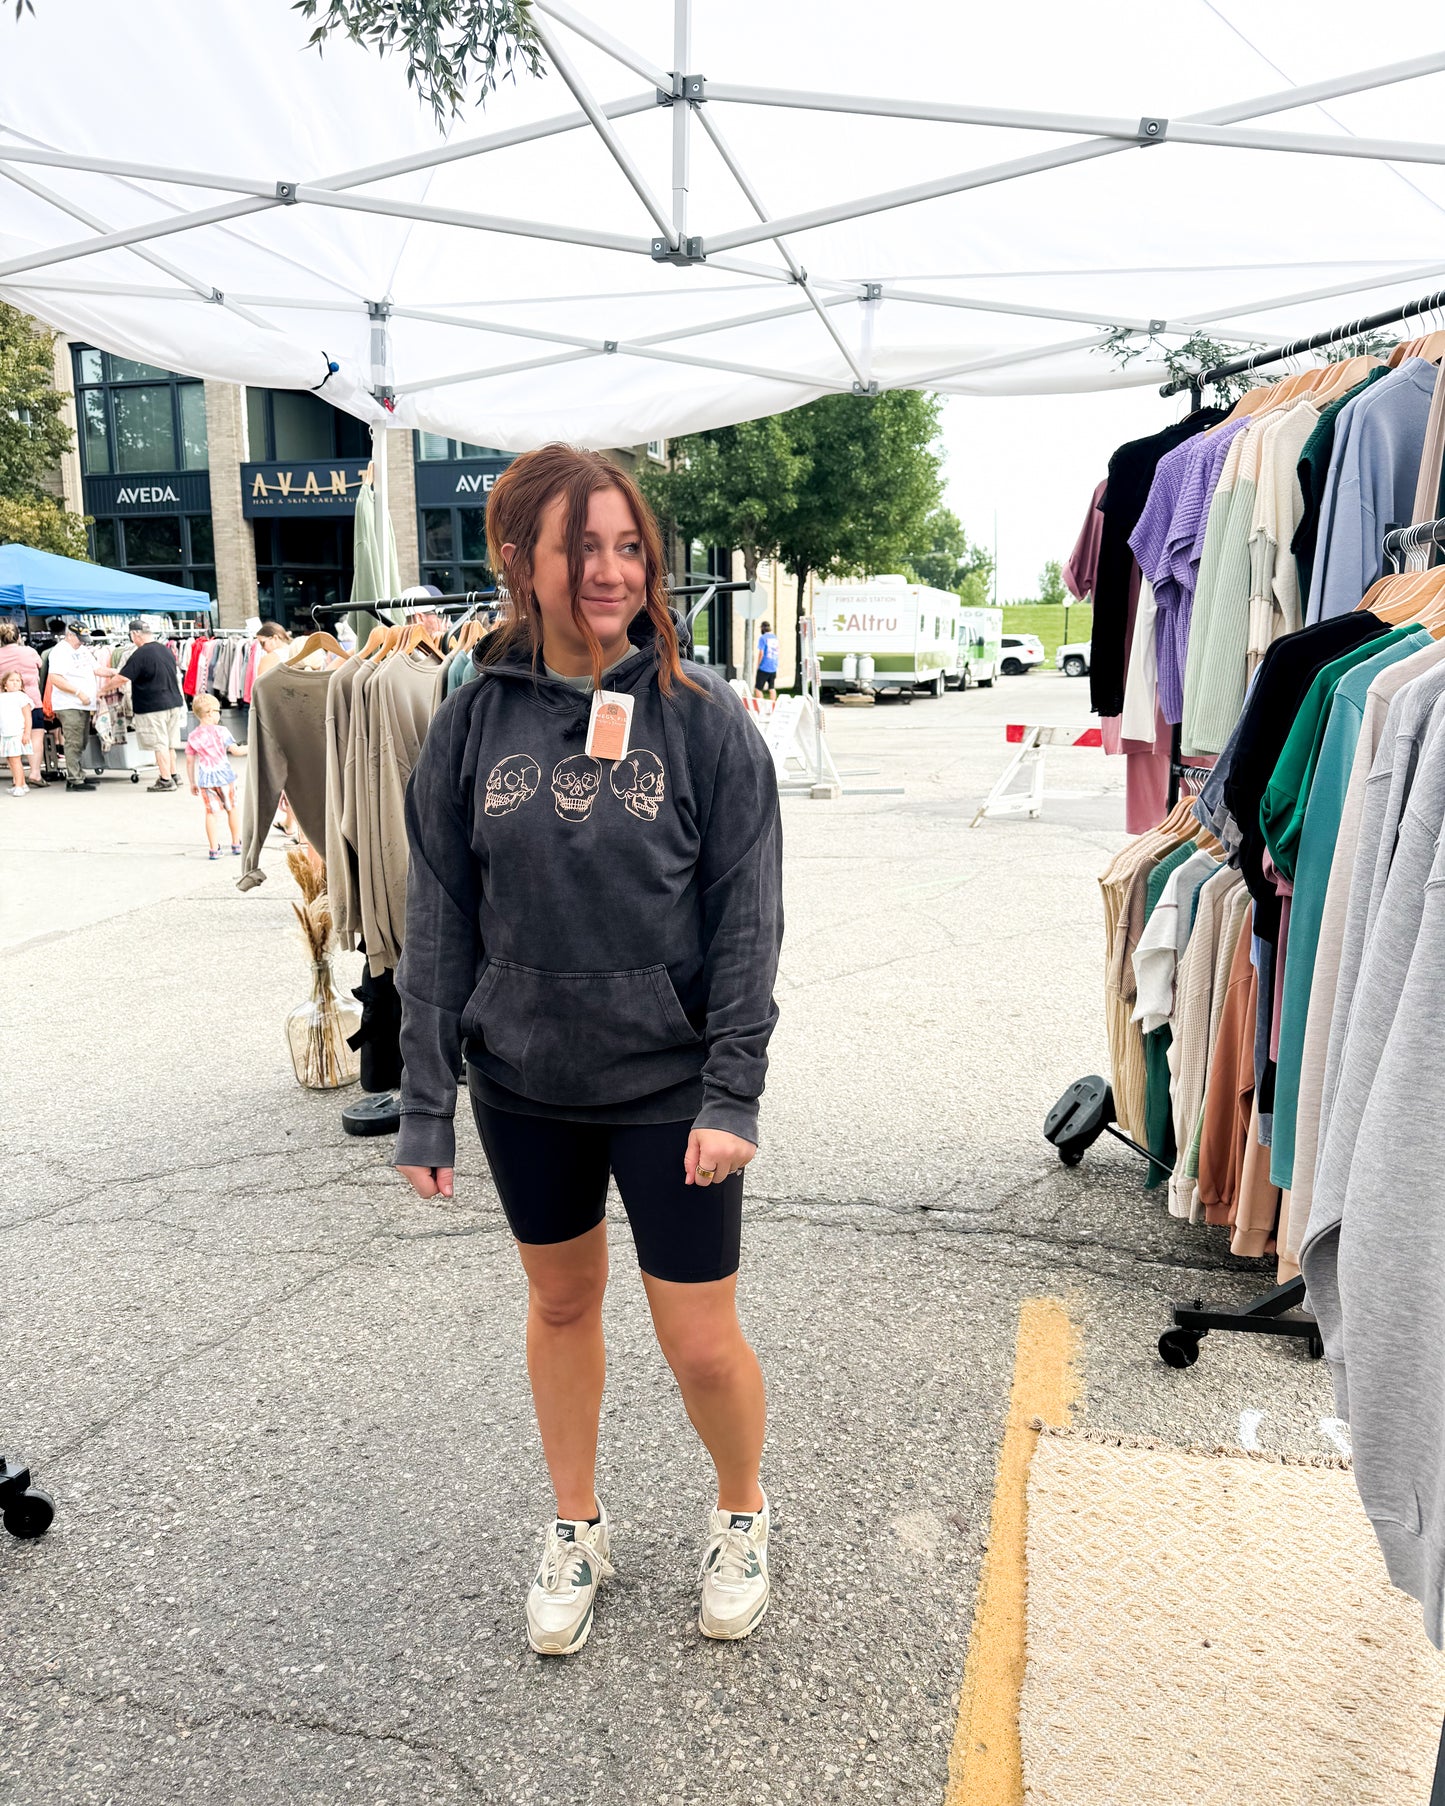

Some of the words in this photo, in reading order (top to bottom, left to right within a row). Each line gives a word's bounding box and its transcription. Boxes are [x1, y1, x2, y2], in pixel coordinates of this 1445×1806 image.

[846, 614, 897, 632] Altru
[735, 1519, 751, 1528] NIKE
[557, 1527, 572, 1536] NIKE
